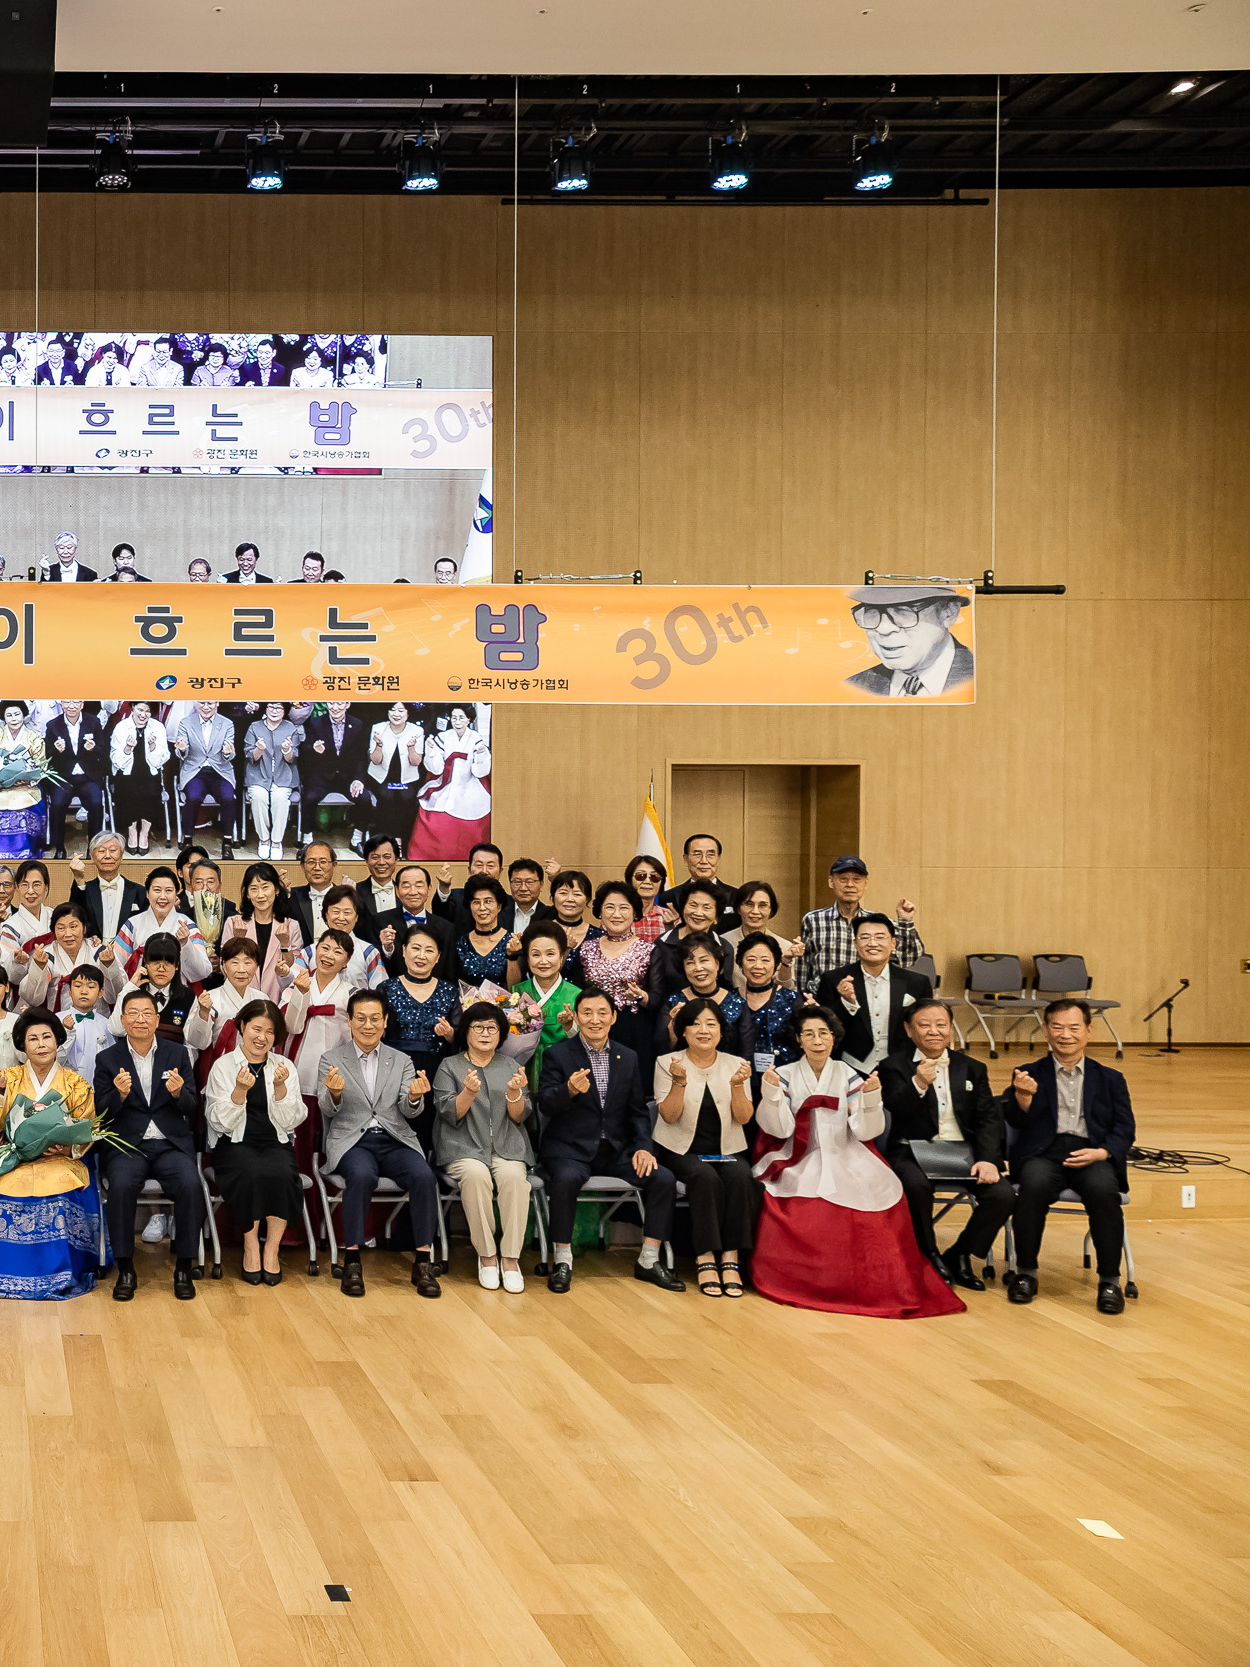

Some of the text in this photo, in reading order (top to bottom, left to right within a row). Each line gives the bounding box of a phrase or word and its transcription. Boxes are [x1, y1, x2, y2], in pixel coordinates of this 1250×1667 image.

[120, 83, 125, 93] 1
[273, 83, 279, 93] 2
[428, 83, 433, 93] 1
[582, 83, 588, 94] 2
[736, 83, 741, 93] 1
[890, 82, 896, 93] 2
[309, 401, 358, 446] 밤
[475, 603, 548, 671] 밤
[615, 601, 770, 690] 30th
[186, 677, 243, 689] 광진구
[322, 675, 400, 691] 광진 문화원
[467, 677, 569, 691] 한국시낭송가협회
